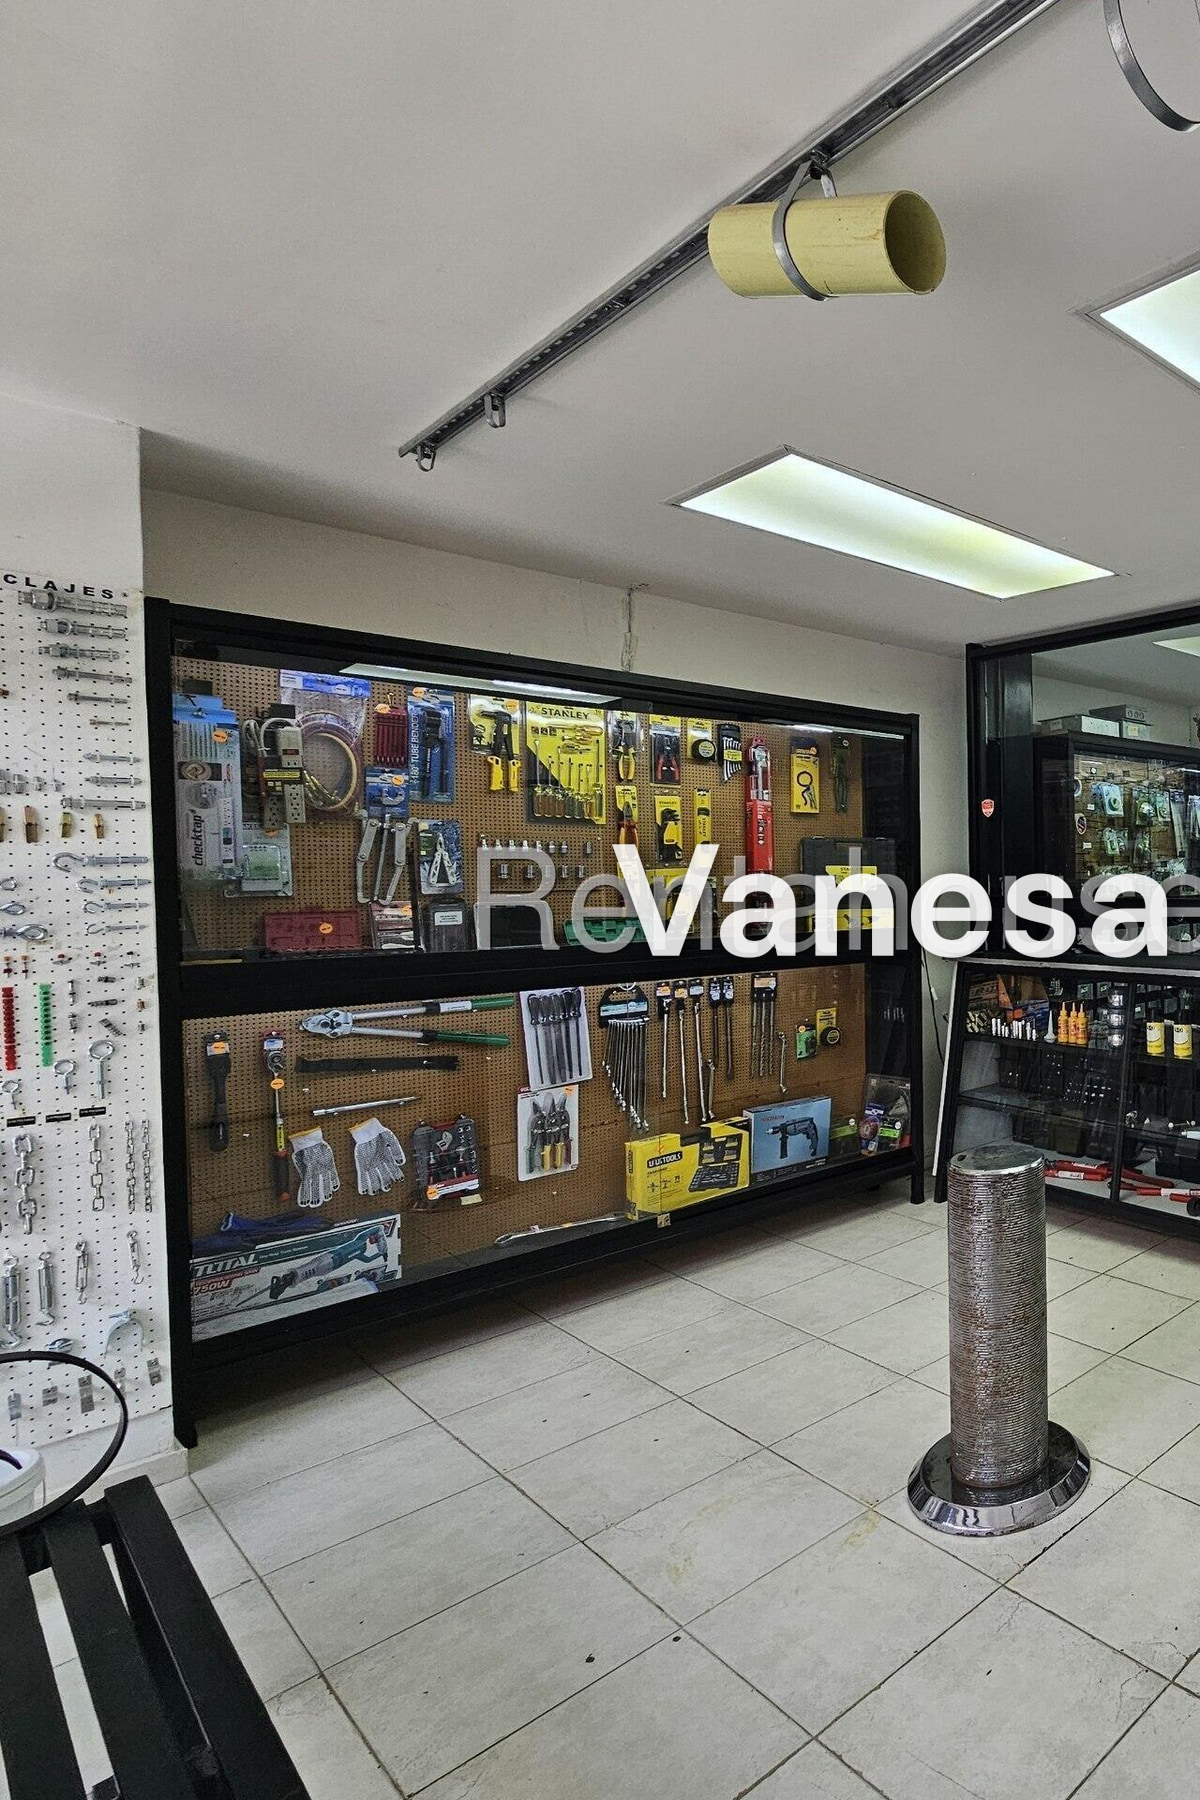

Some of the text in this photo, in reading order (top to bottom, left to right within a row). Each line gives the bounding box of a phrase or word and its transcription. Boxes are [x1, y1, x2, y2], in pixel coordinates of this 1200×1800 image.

[541, 707, 590, 720] STANLEY
[411, 743, 419, 763] TUBE
[193, 1280, 230, 1296] 750W
